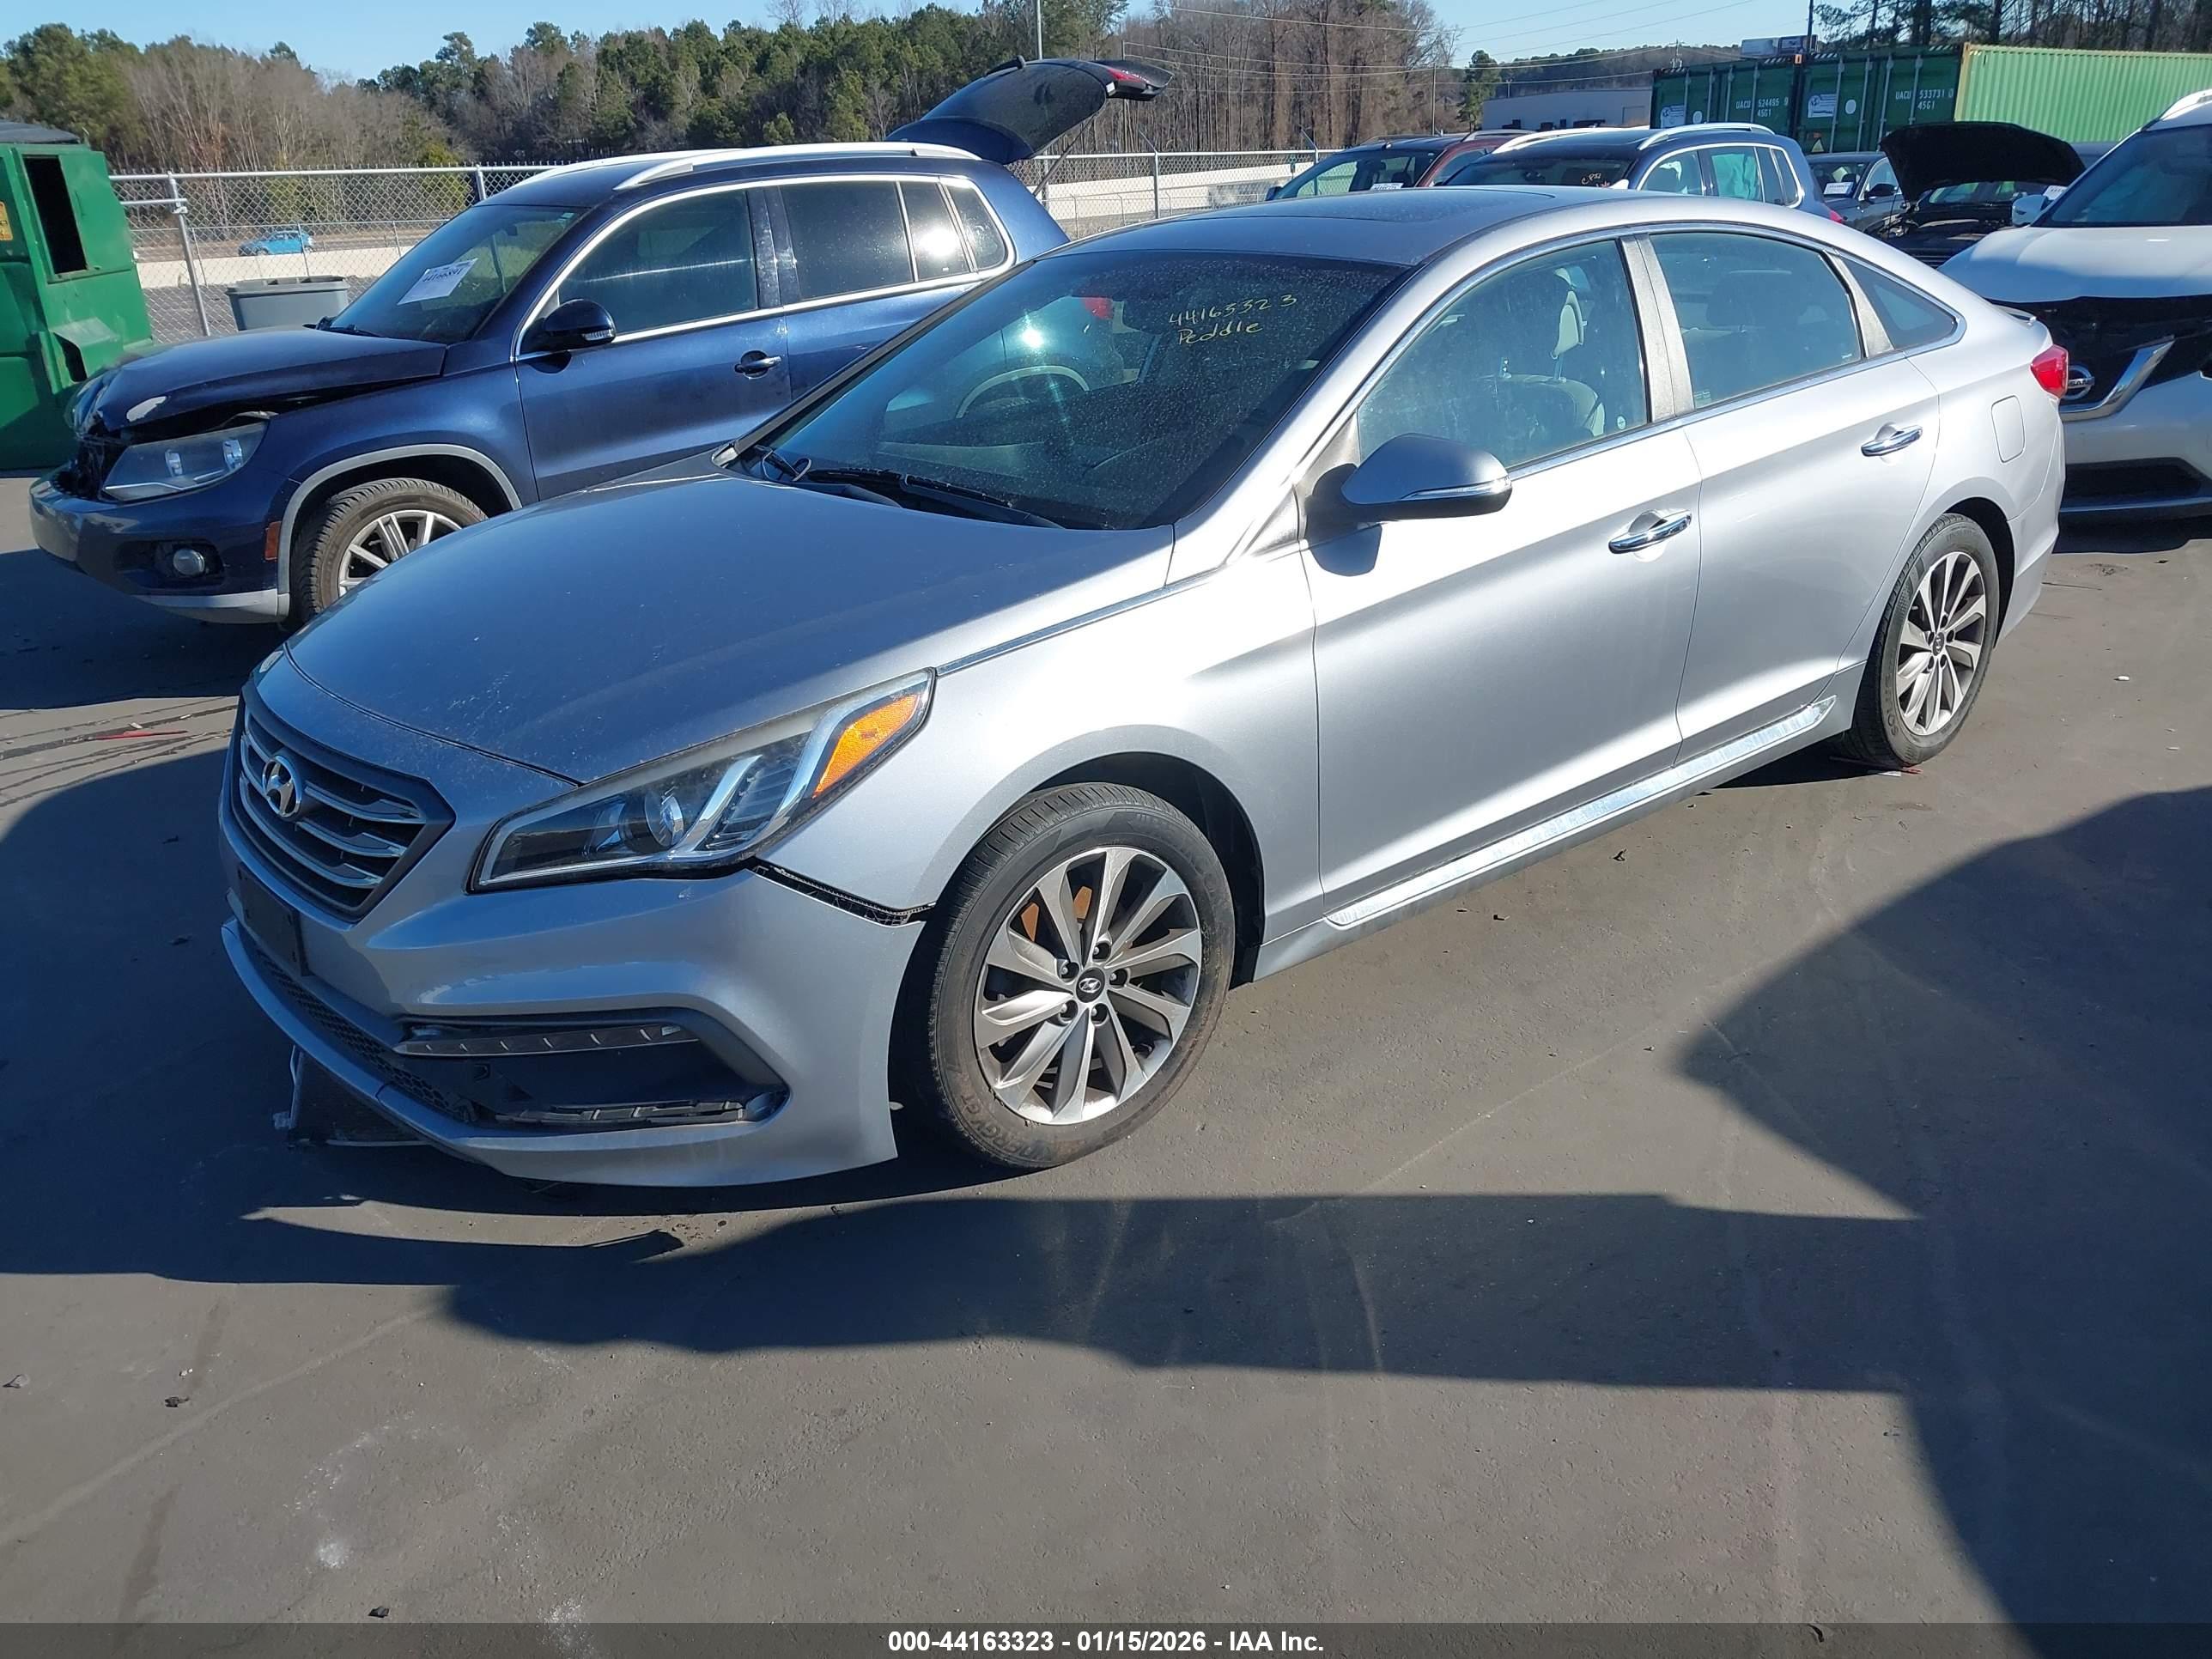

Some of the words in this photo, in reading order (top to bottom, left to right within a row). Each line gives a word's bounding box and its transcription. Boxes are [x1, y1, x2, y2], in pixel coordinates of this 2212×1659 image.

[1895, 90, 1911, 100] UACU
[1918, 88, 1945, 100] 533731
[1735, 99, 1752, 110] UACU
[1917, 100, 1936, 111] 45G1
[1757, 108, 1771, 118] 45G1
[1177, 320, 1264, 344] Peddle
